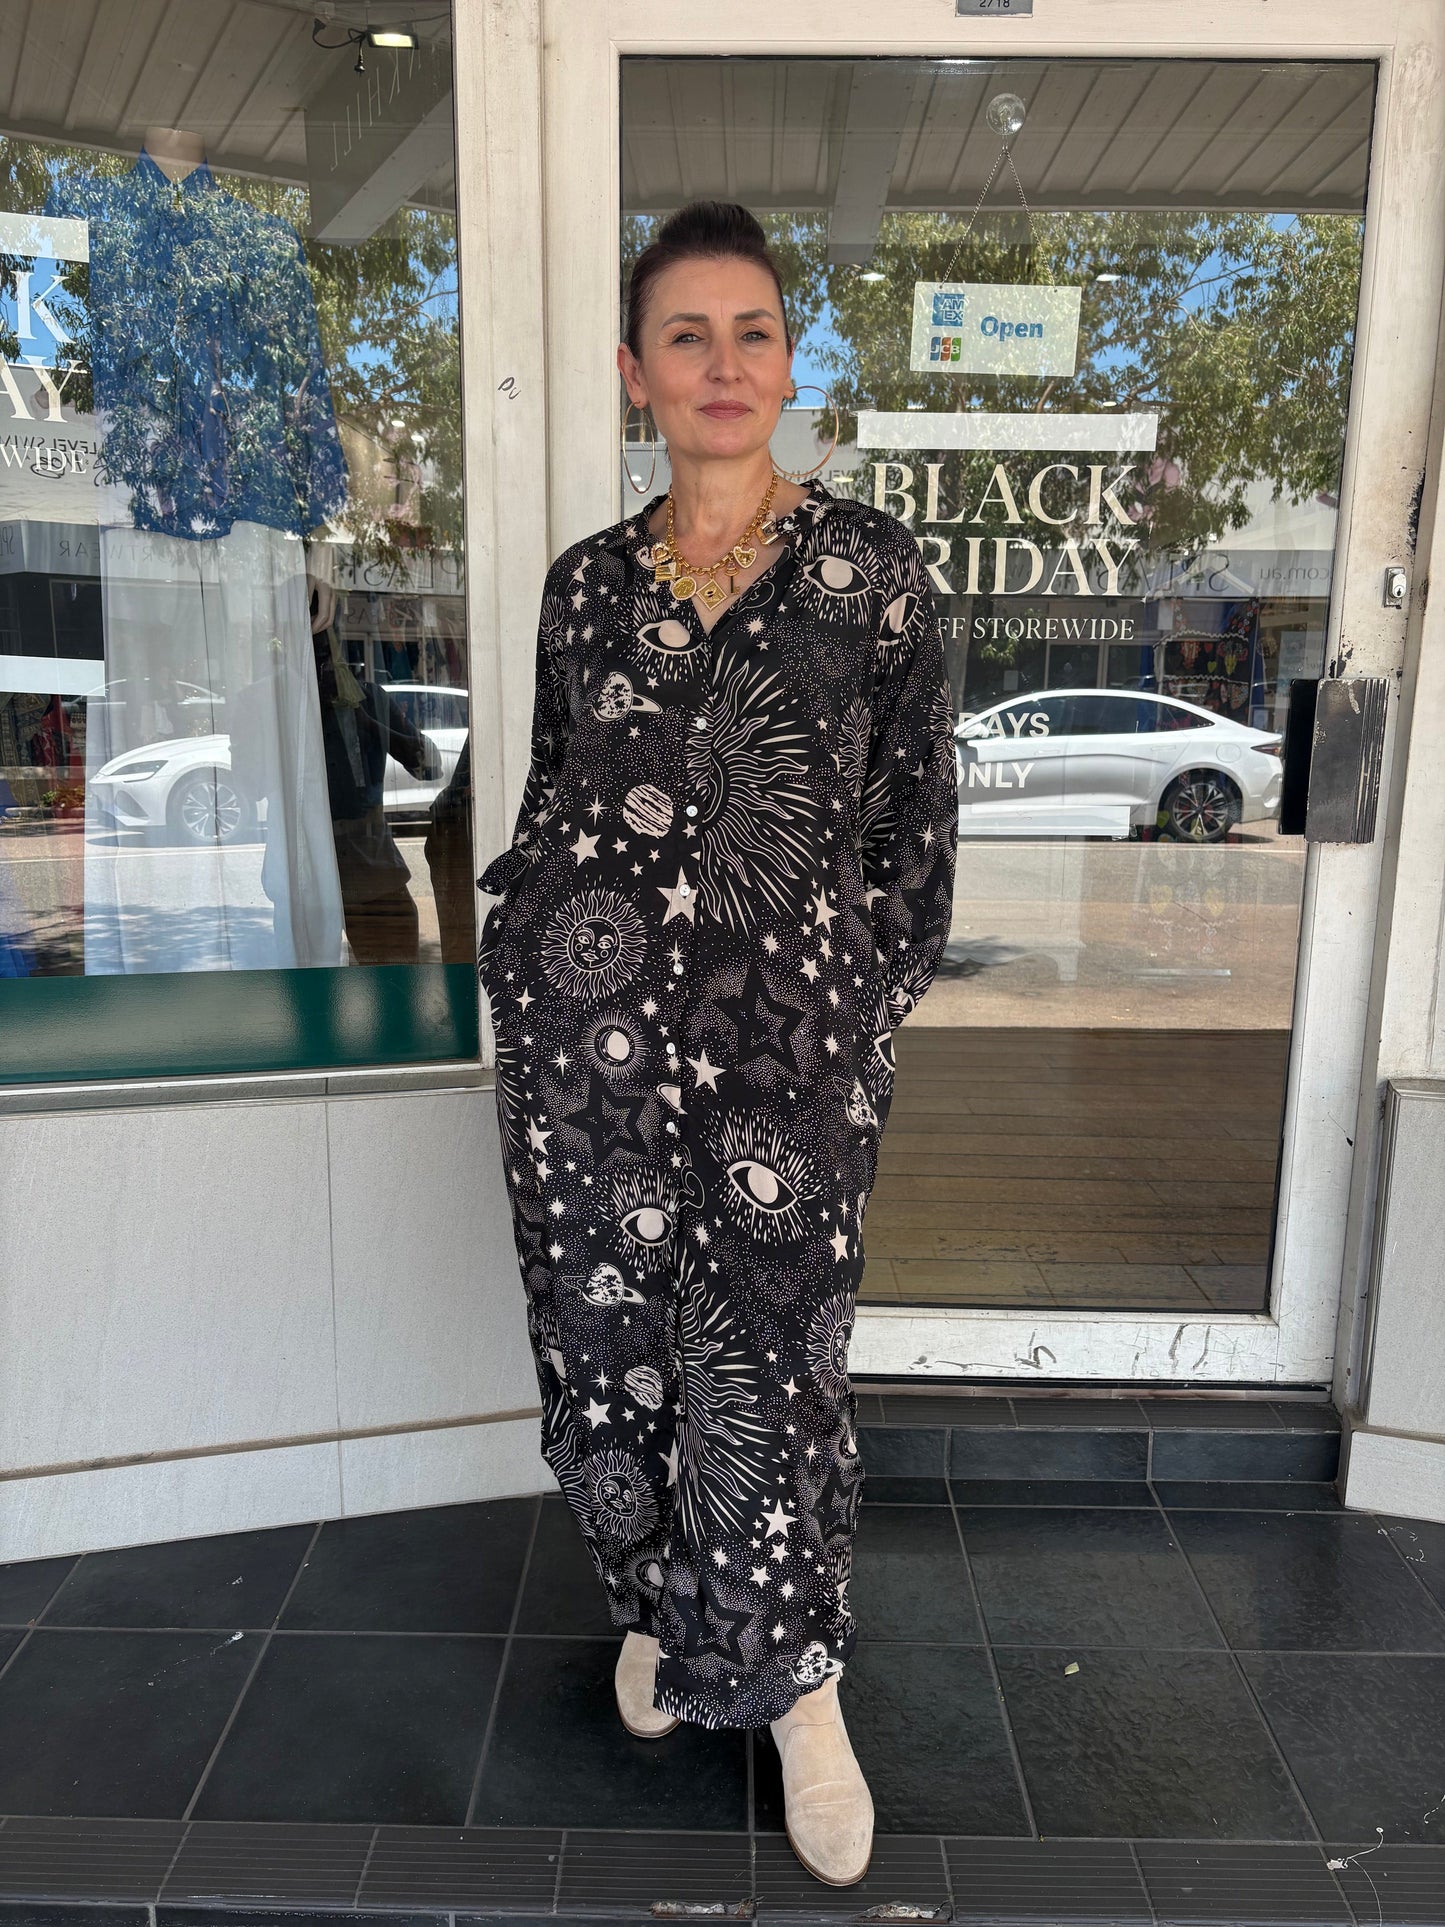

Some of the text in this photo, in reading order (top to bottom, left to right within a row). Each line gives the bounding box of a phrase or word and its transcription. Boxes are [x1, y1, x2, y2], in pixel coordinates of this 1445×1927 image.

[980, 315, 1044, 342] Open
[870, 462, 1137, 525] BLACK
[914, 536, 1141, 596] RIDAY
[937, 617, 1135, 640] FF STOREWIDE
[958, 712, 1050, 739] DAYS
